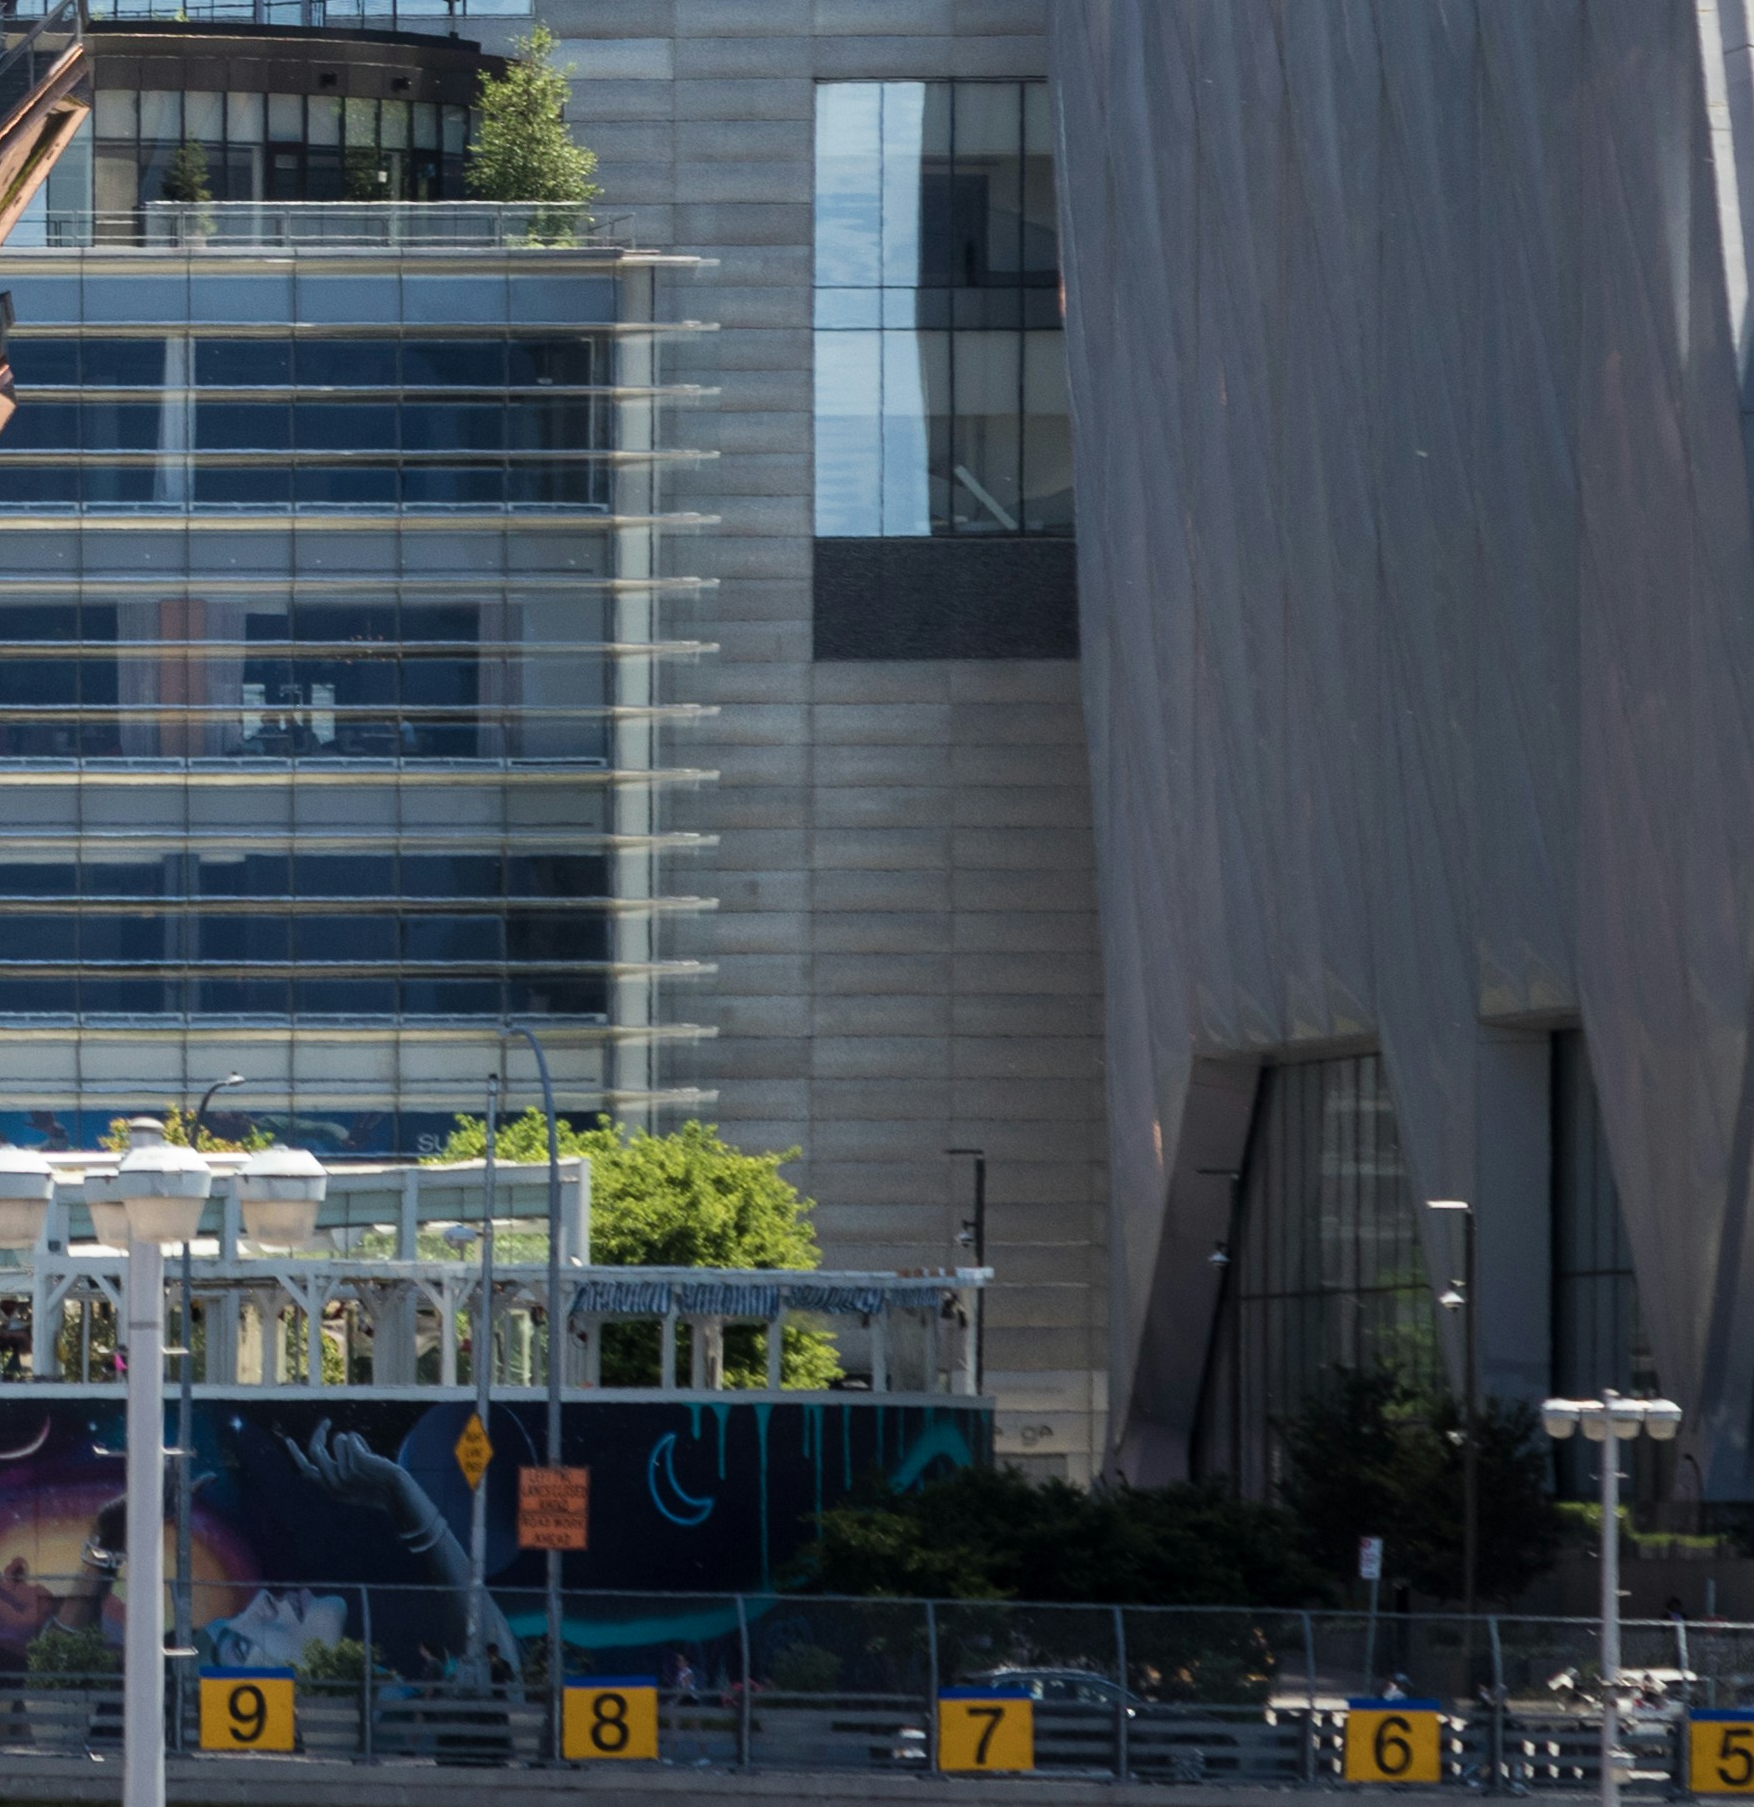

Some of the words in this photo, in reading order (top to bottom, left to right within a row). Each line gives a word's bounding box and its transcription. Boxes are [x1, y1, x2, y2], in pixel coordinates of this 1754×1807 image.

[228, 1684, 267, 1743] 9
[590, 1692, 630, 1753] 8
[967, 1707, 1005, 1765] 7
[1373, 1716, 1413, 1776] 6
[1716, 1728, 1754, 1787] 5
